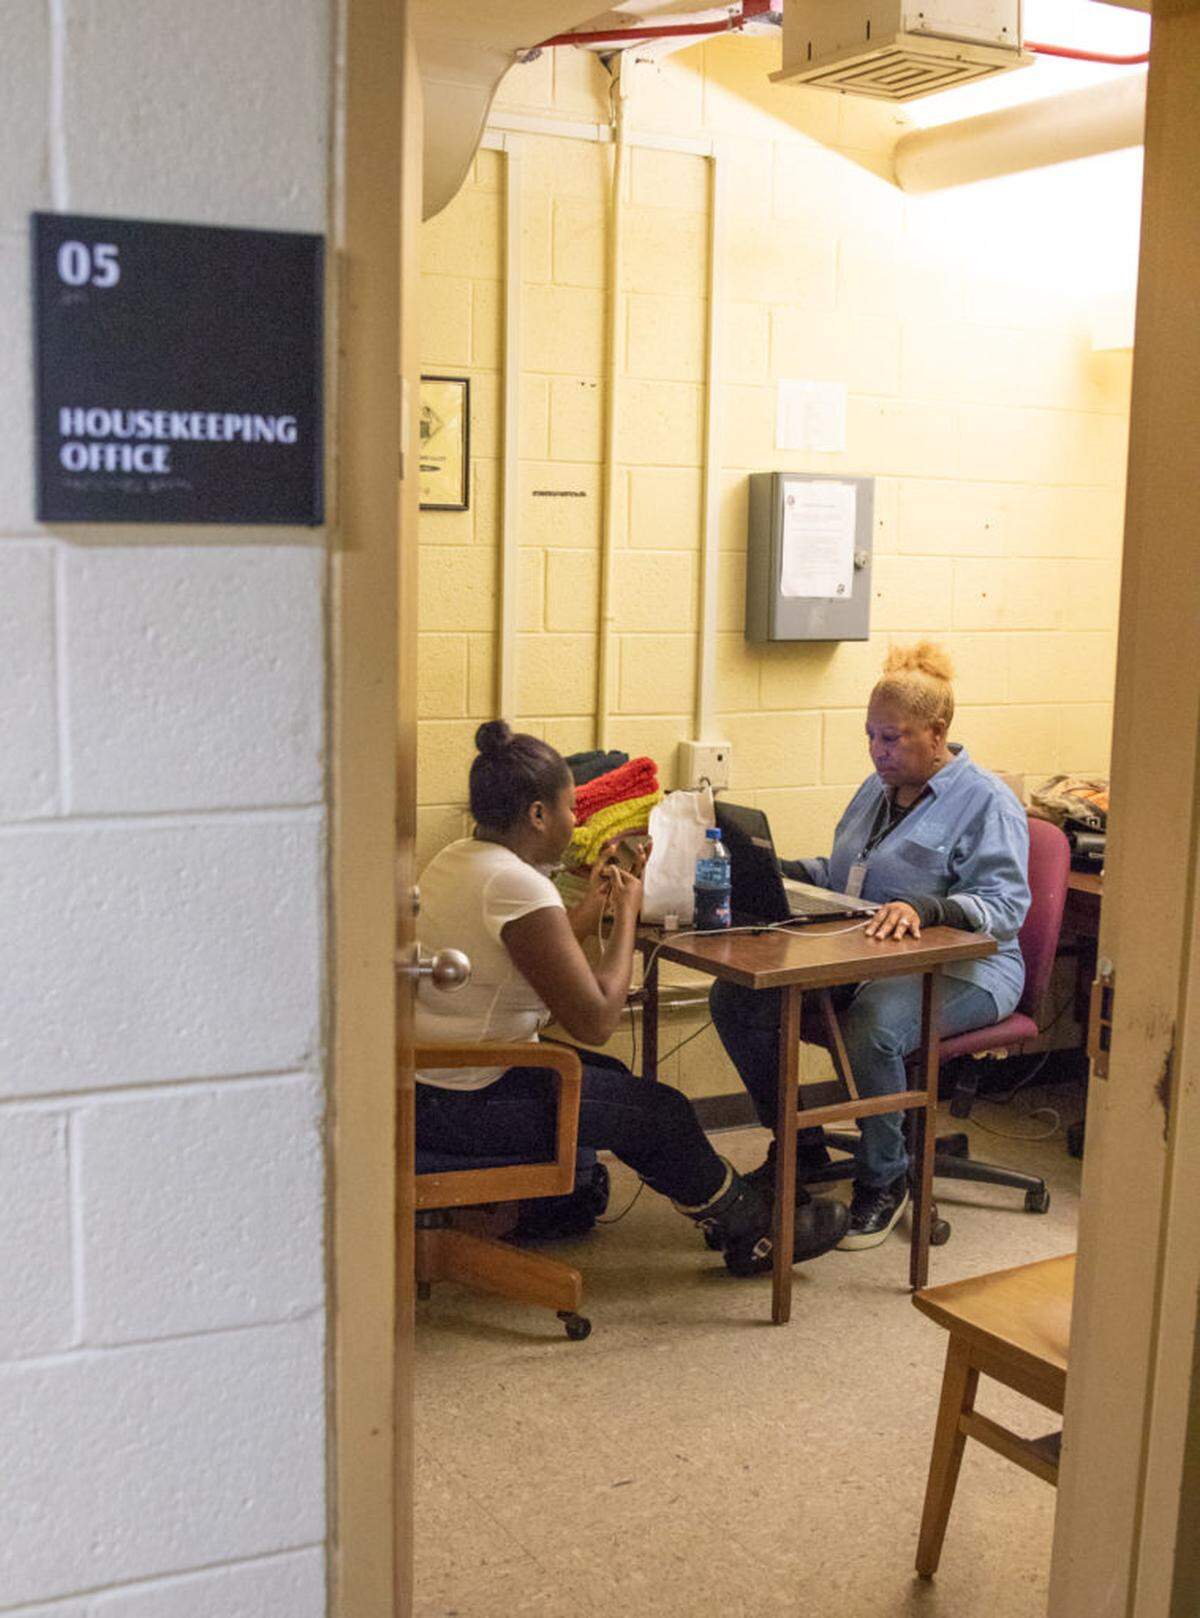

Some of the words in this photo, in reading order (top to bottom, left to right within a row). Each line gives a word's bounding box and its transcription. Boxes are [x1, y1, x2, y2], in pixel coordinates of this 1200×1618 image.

[58, 240, 120, 288] 05
[59, 406, 298, 444] HOUSEKEEPING
[59, 442, 170, 473] OFFICE
